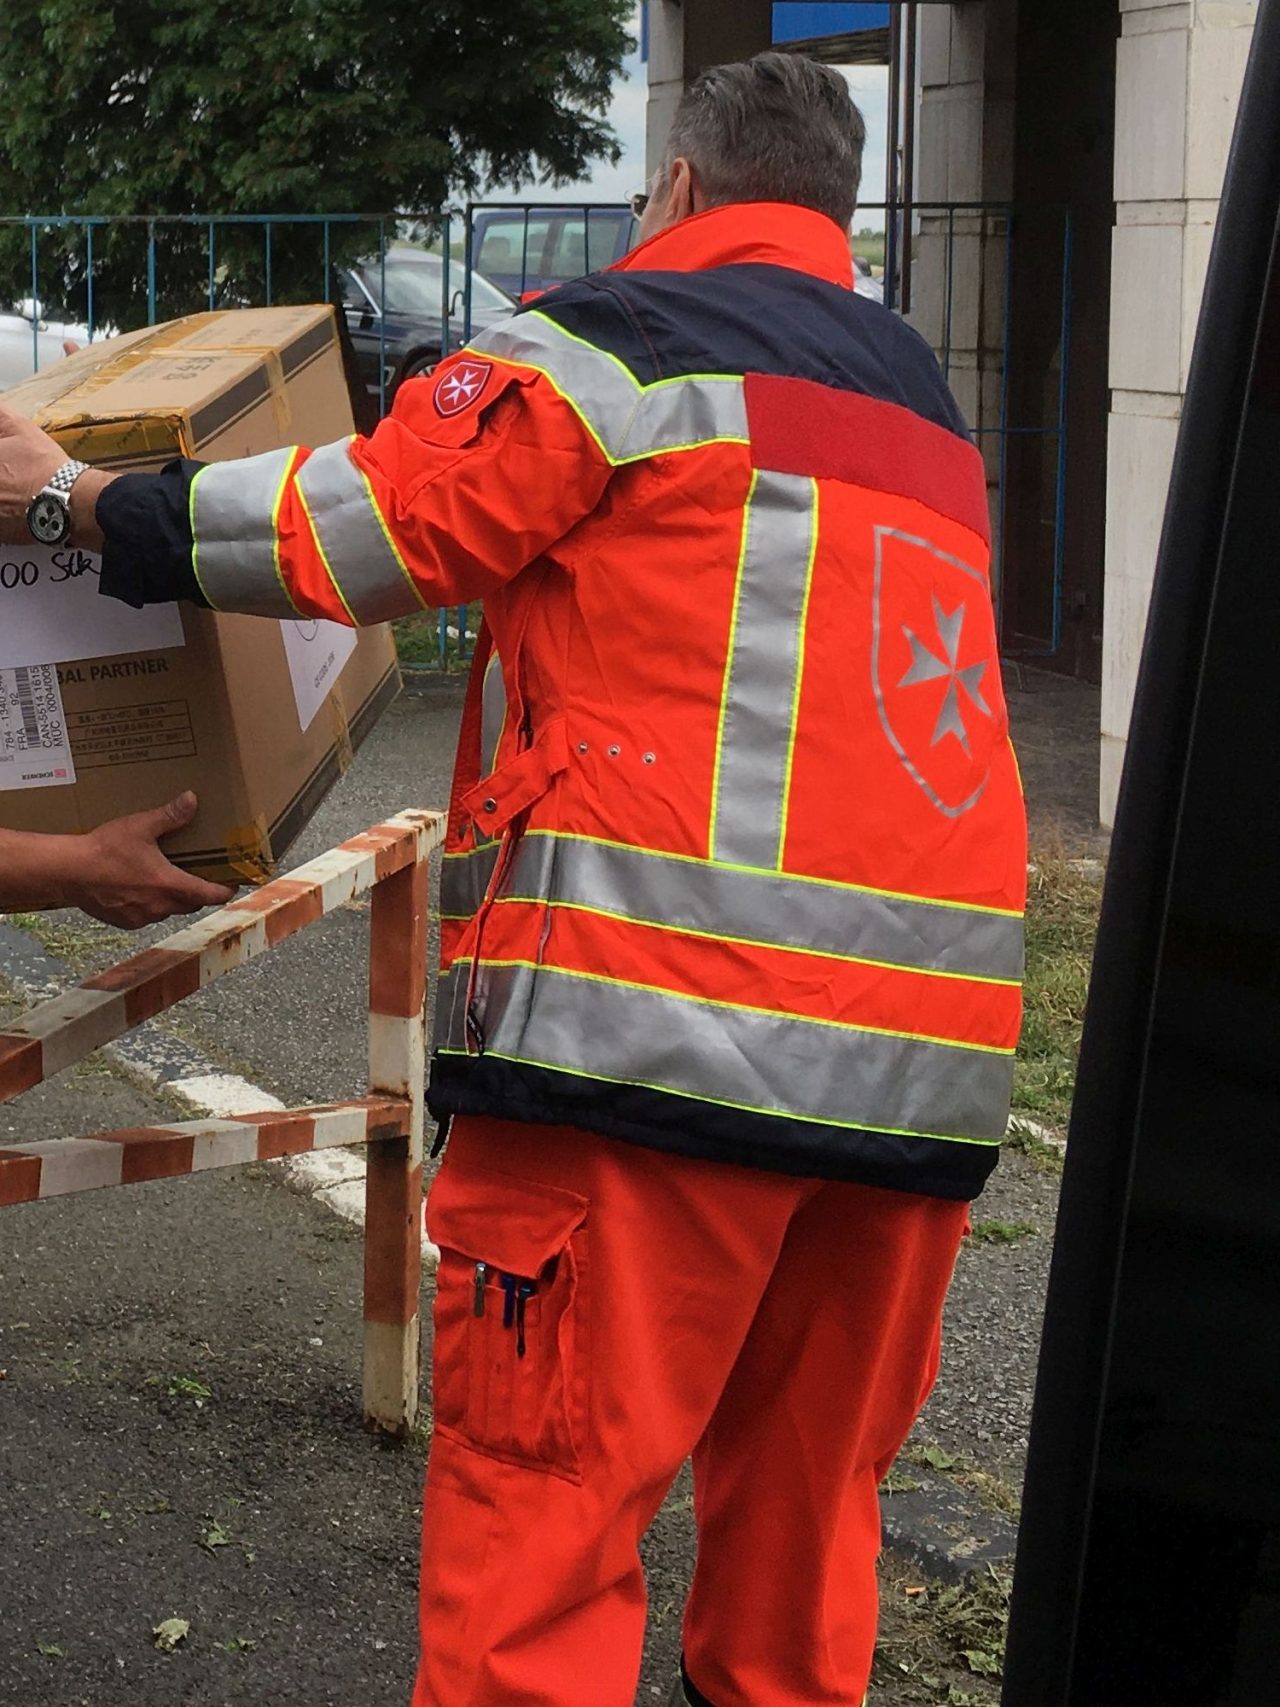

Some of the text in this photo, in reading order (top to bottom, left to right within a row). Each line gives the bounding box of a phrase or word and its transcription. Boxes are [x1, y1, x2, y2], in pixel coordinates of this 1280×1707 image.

[90, 657, 169, 681] PARTNER
[31, 667, 52, 748] CAN-5514 1615
[10, 692, 28, 750] FRA 92
[51, 721, 63, 747] MUC
[5, 731, 16, 750] 784
